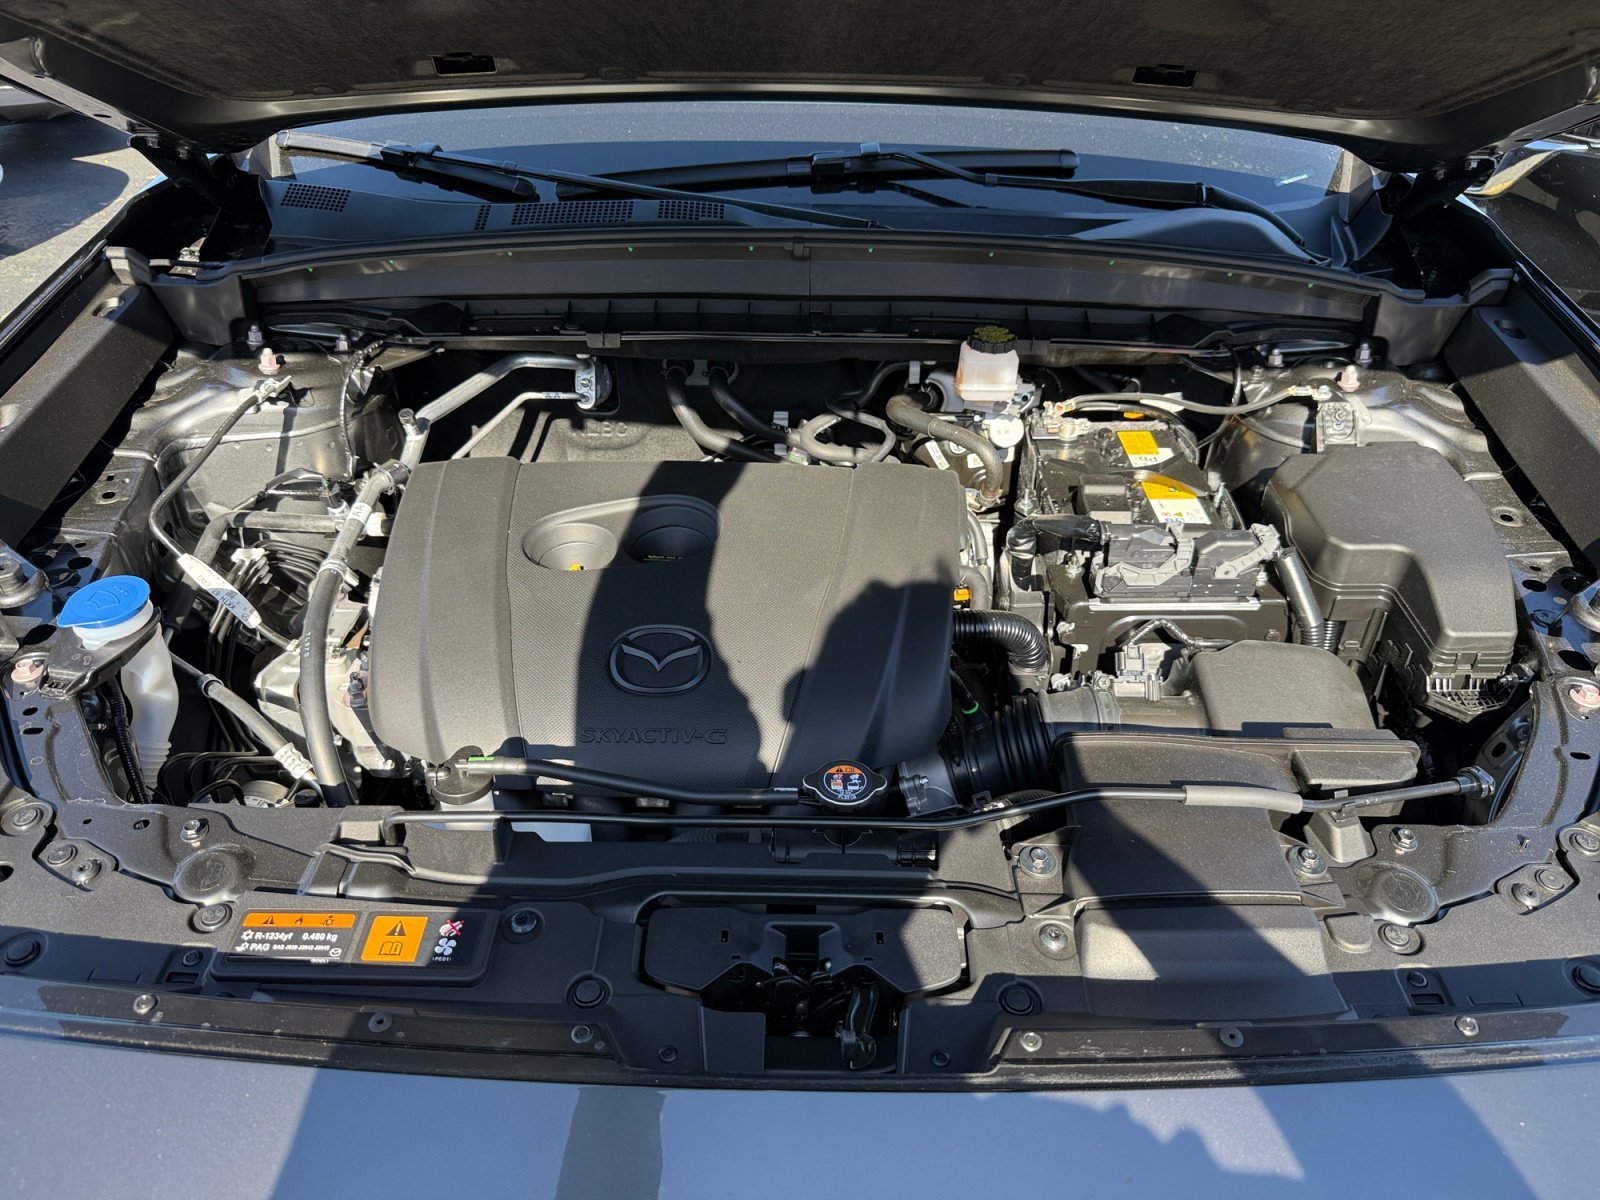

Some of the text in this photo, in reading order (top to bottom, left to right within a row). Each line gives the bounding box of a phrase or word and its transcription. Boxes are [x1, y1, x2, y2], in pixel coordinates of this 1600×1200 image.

[578, 727, 728, 745] SKYACTIV-G
[254, 931, 293, 942] R-1234yf
[326, 933, 338, 943] kg
